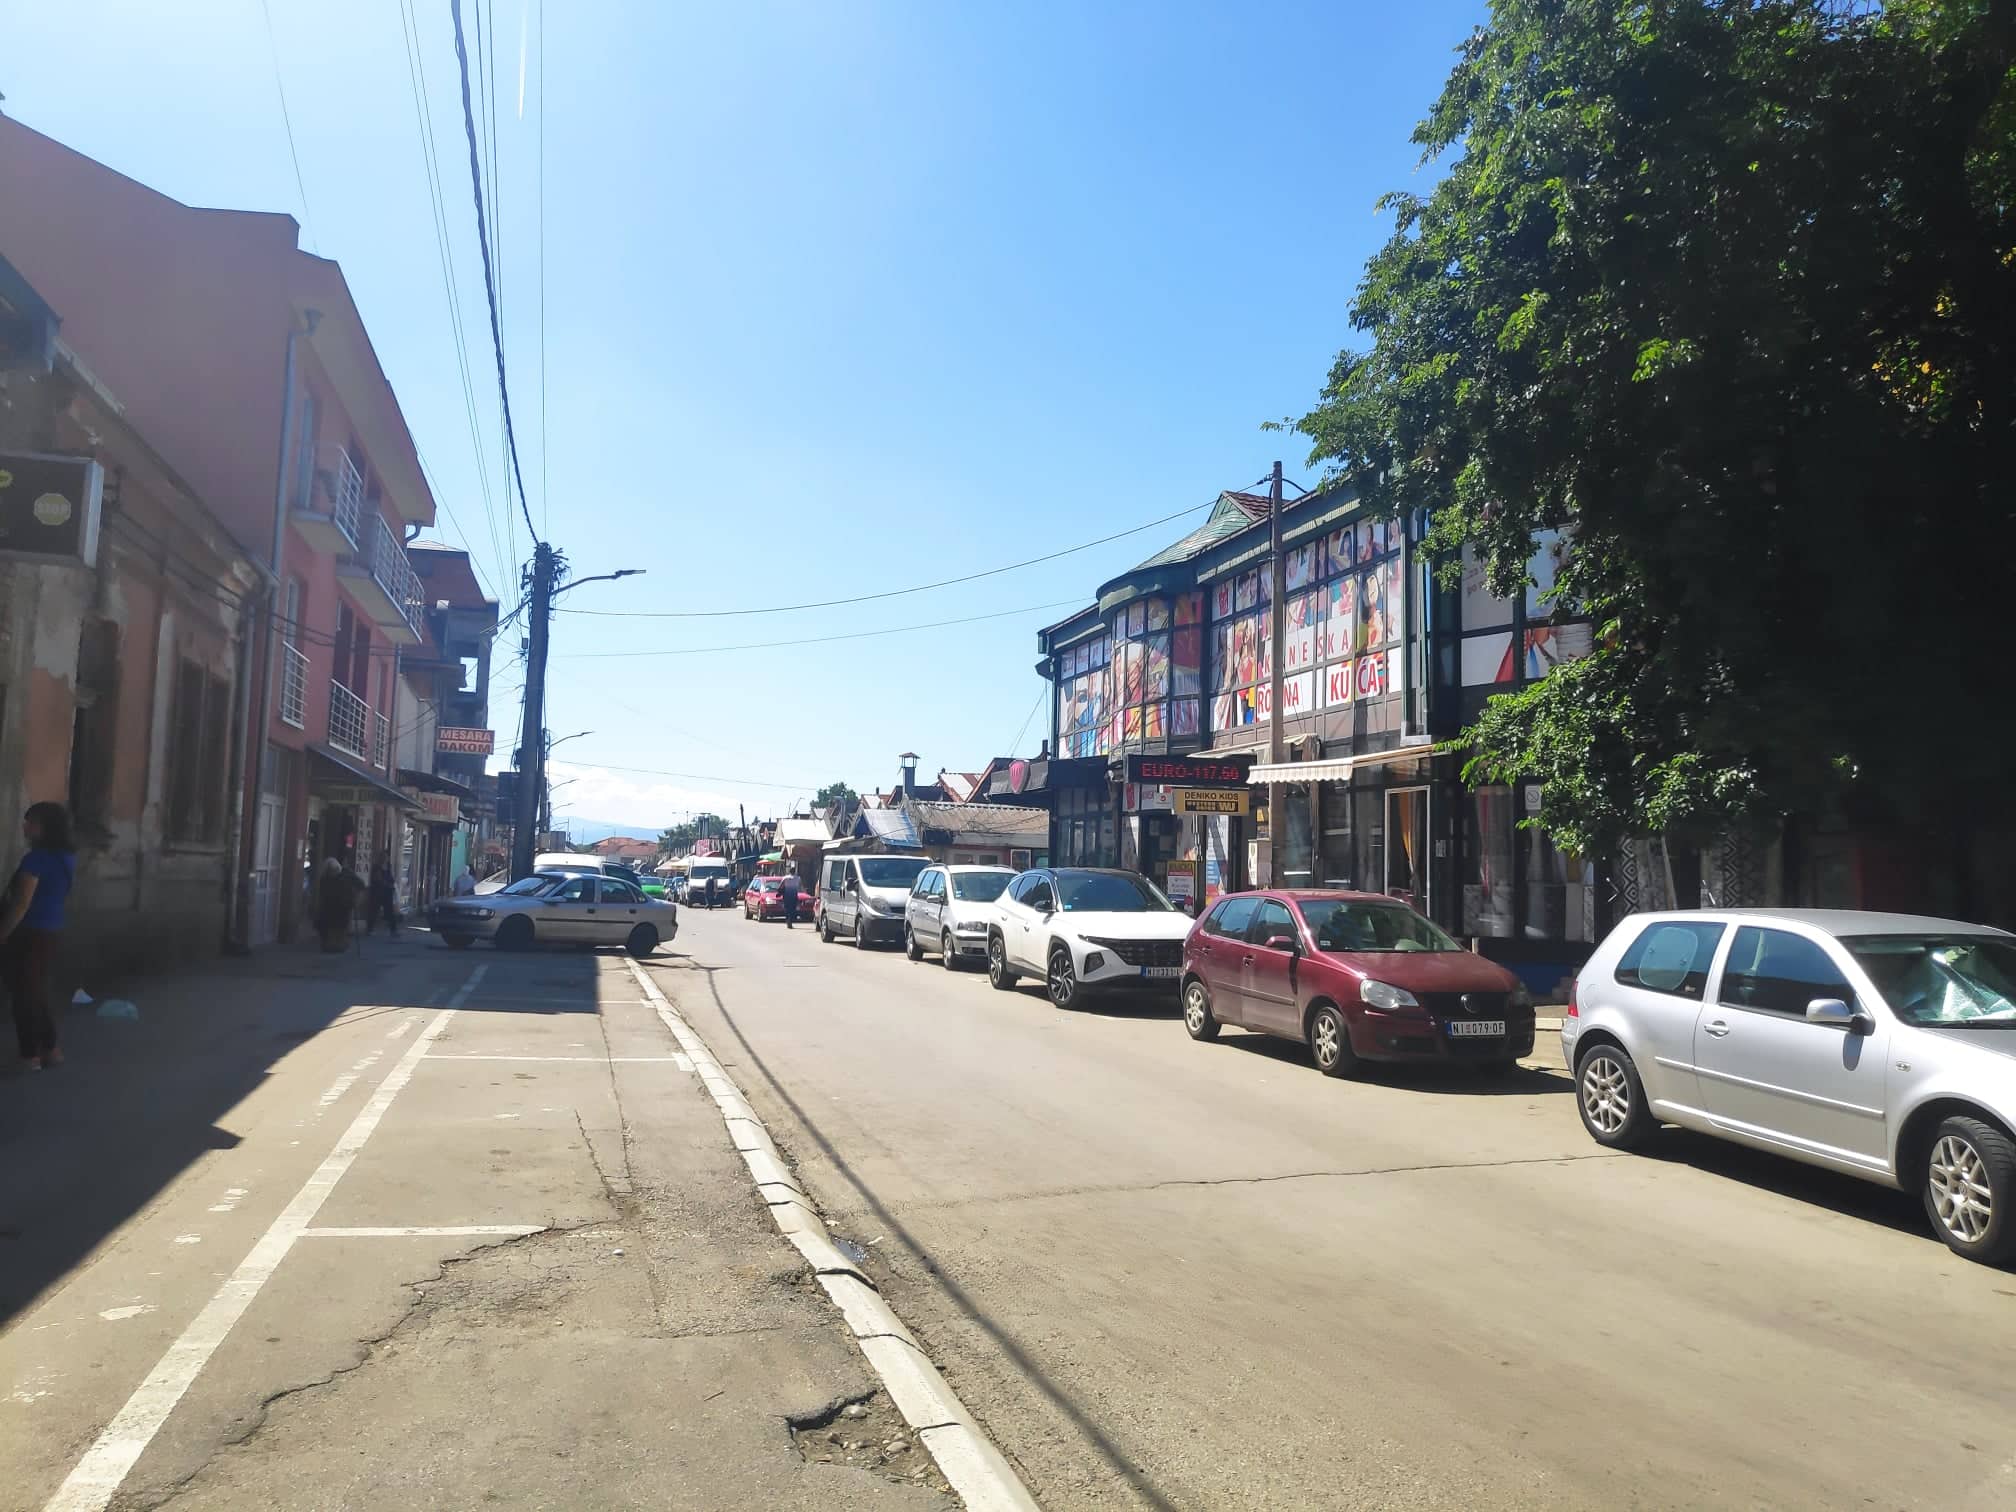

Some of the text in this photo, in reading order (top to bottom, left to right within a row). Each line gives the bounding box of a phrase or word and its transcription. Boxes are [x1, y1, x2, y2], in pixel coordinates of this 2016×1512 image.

[1258, 681, 1299, 714] RONA
[440, 729, 491, 742] MESARA
[439, 741, 491, 753] DAKOM
[1184, 791, 1239, 801] DENIKO KIDS
